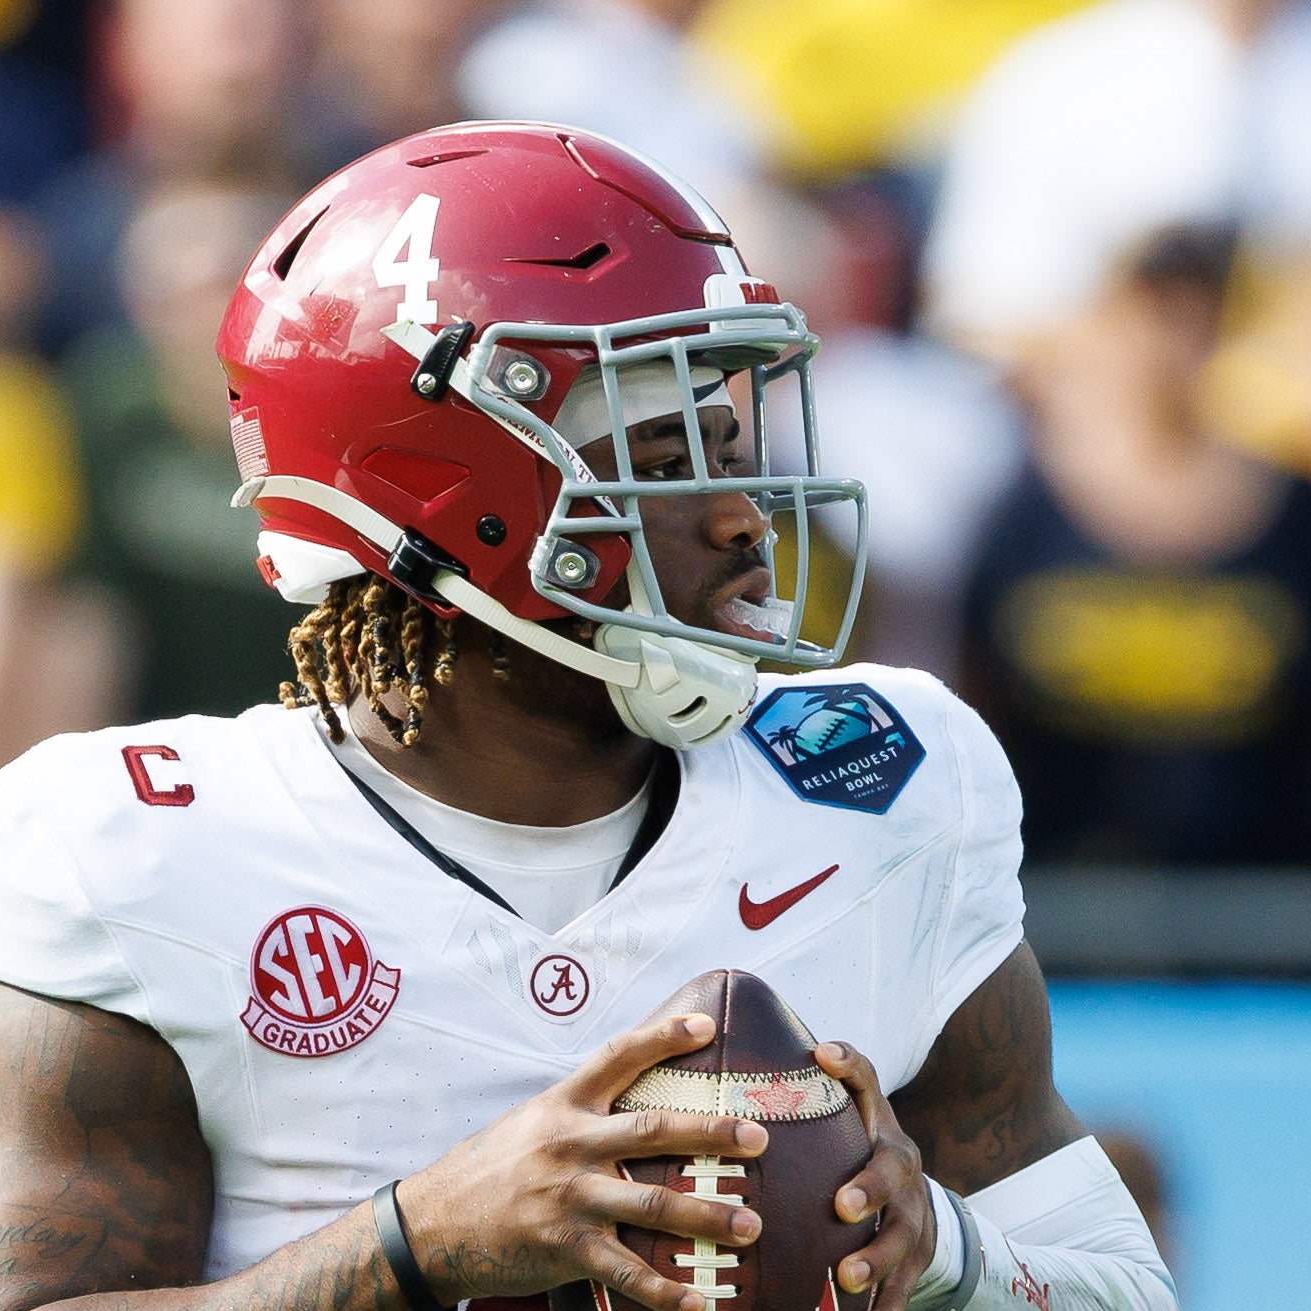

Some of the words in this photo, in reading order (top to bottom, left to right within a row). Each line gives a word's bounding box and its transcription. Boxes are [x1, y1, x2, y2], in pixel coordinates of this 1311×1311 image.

[373, 192, 440, 324] 4
[122, 745, 195, 807] C
[801, 747, 898, 790] RELIAQUEST
[845, 772, 883, 791] BOWL
[259, 914, 362, 1018] SEC
[263, 994, 387, 1054] GRADUATE
